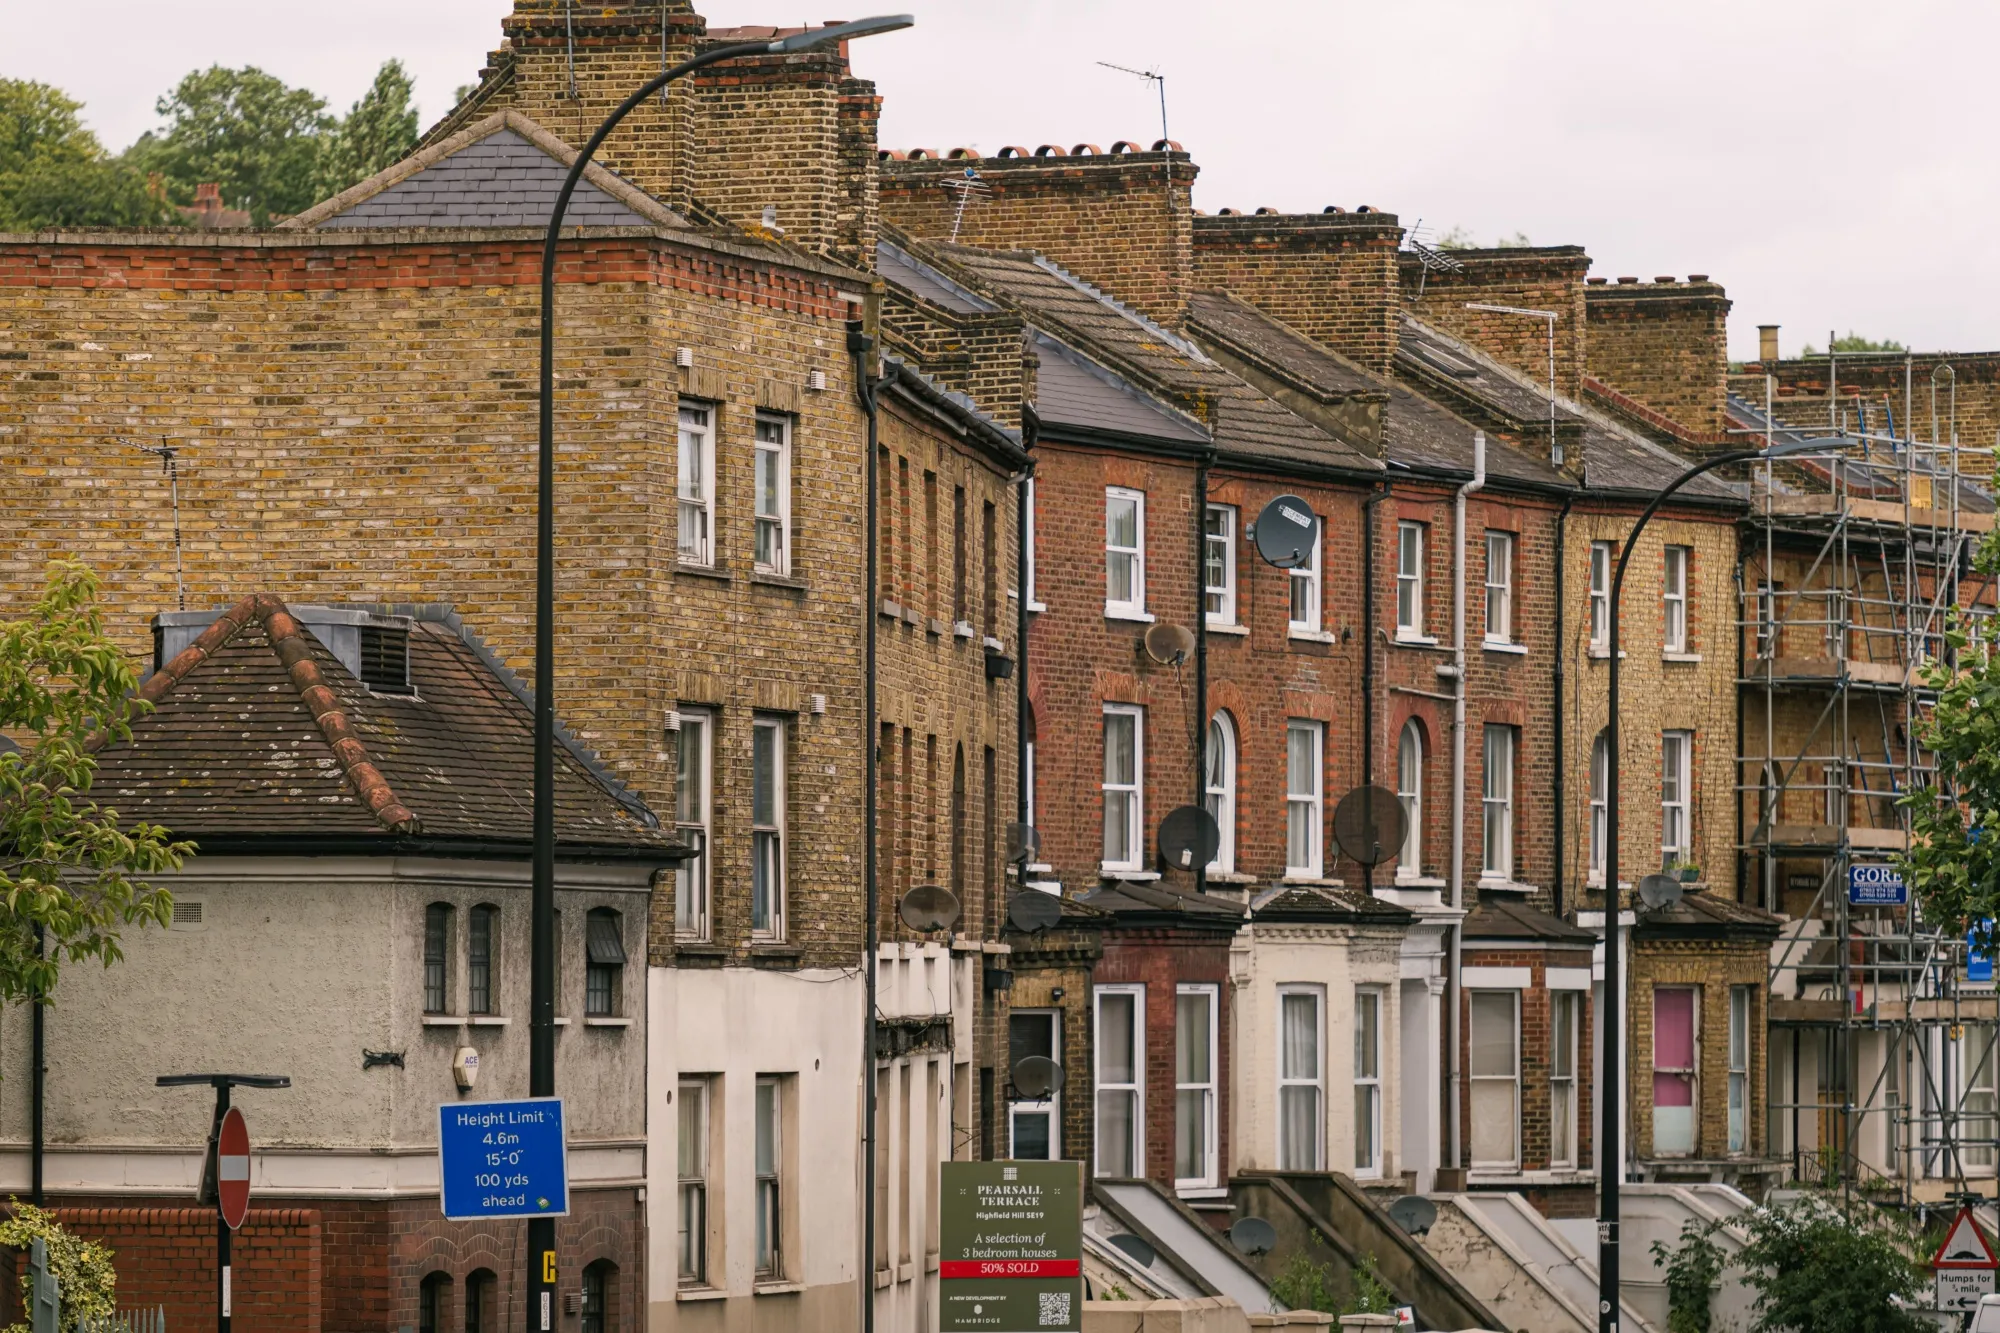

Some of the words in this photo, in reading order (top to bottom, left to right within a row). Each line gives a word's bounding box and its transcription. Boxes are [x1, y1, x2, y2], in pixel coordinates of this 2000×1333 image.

[1854, 868, 1903, 882] GORE
[465, 1056, 478, 1064] ACE
[457, 1112, 505, 1128] Height
[509, 1110, 544, 1123] Limit
[483, 1133, 519, 1145] 4.6m
[475, 1174, 500, 1186] 100
[505, 1173, 529, 1188] yds
[977, 1185, 1043, 1195] PEARSALL
[482, 1194, 525, 1207] ahead
[979, 1197, 1040, 1206] TERRACE
[976, 1212, 1010, 1220] Highfield
[975, 1234, 983, 1243] A
[985, 1233, 1032, 1244] selection
[1034, 1232, 1046, 1246] of
[963, 1248, 970, 1258] 3
[972, 1247, 1018, 1258] bedroom
[1021, 1247, 1057, 1258] houses
[981, 1263, 1004, 1274] 50%
[1007, 1262, 1039, 1273] SOLD
[1941, 1274, 1974, 1283] Humps
[1977, 1274, 1991, 1282] for
[1960, 1284, 1980, 1293] mile
